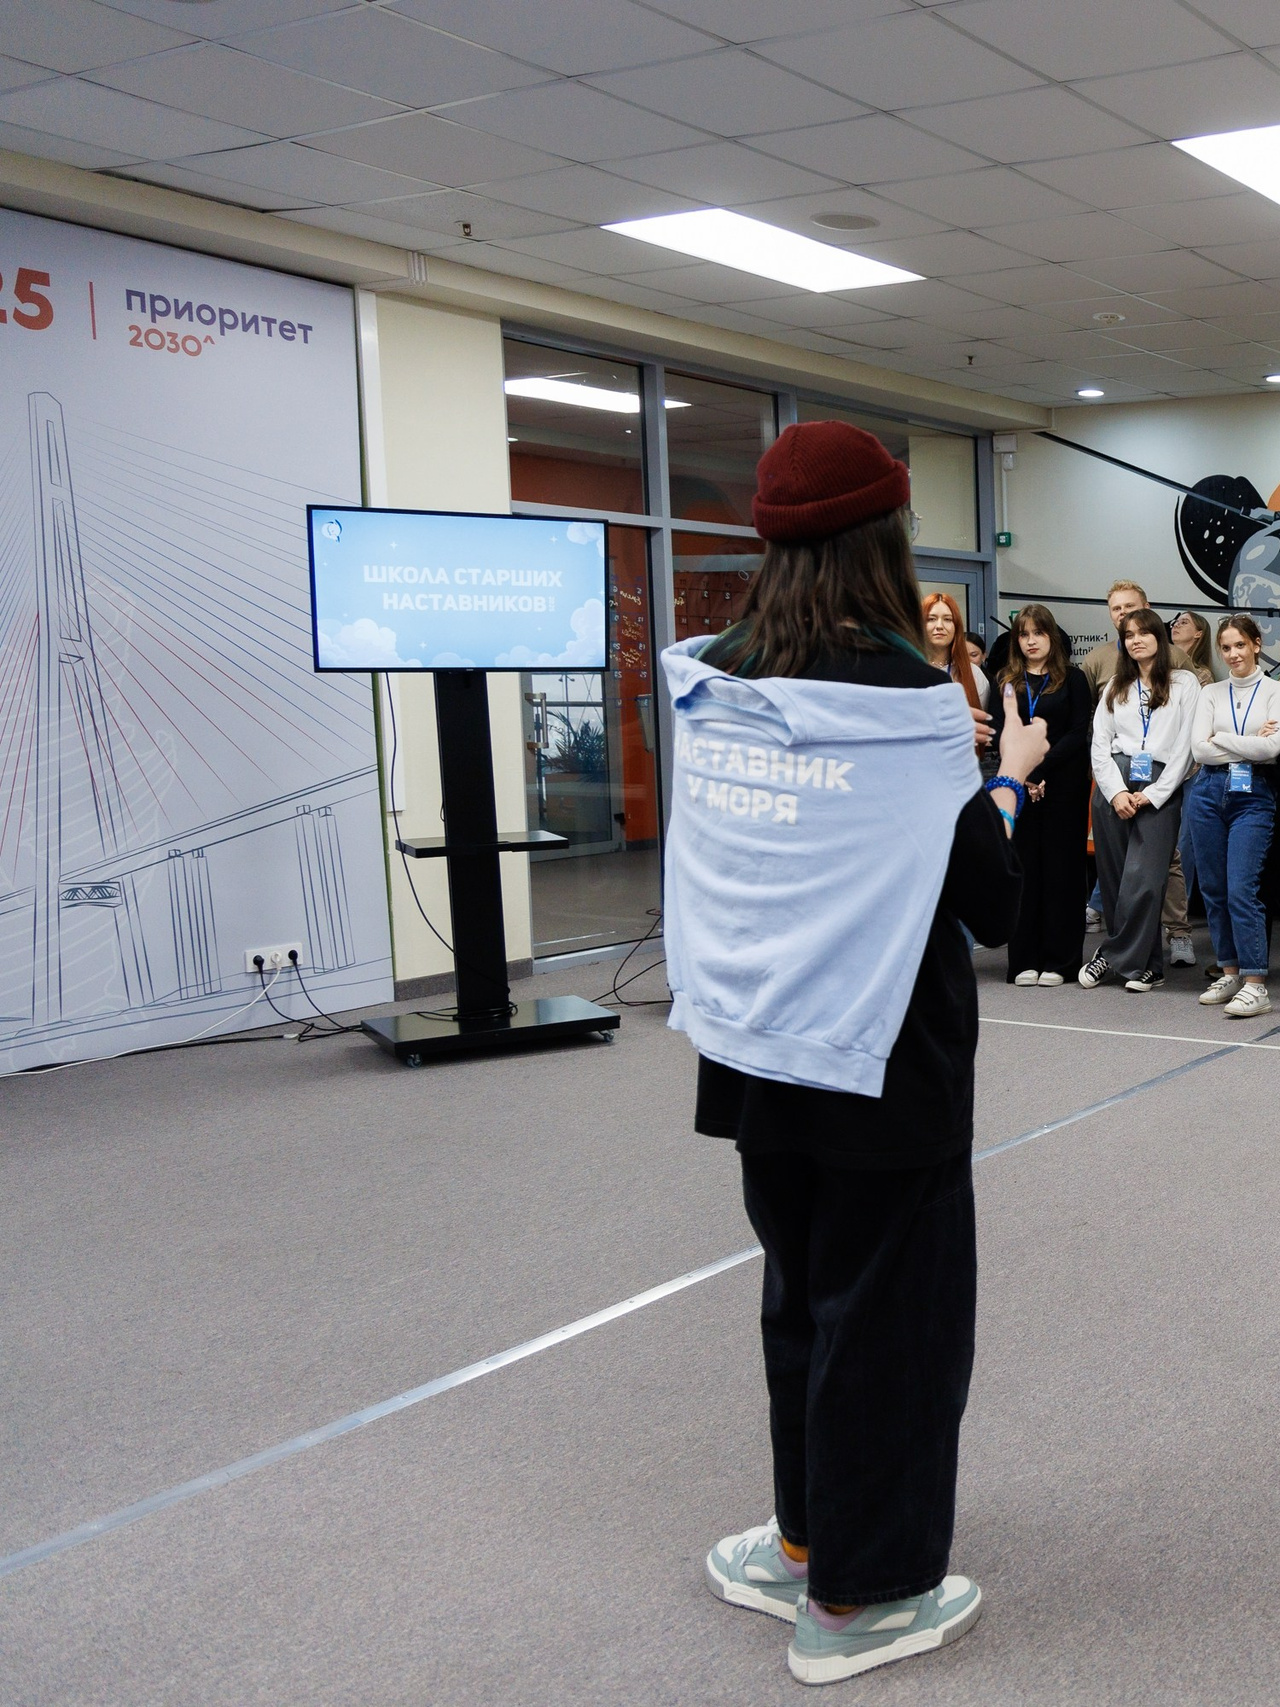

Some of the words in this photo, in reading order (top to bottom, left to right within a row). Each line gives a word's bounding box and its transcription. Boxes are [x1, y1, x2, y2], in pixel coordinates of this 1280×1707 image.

[0, 267, 55, 331] 5
[125, 289, 313, 344] приоритет
[363, 565, 450, 585] ШКОЛА
[454, 568, 563, 587] СТАРШИХ
[382, 592, 547, 613] НАСТАВНИКОВ
[1068, 633, 1108, 644] путник-1
[687, 774, 703, 803] У
[706, 779, 798, 825] МОРЯ
